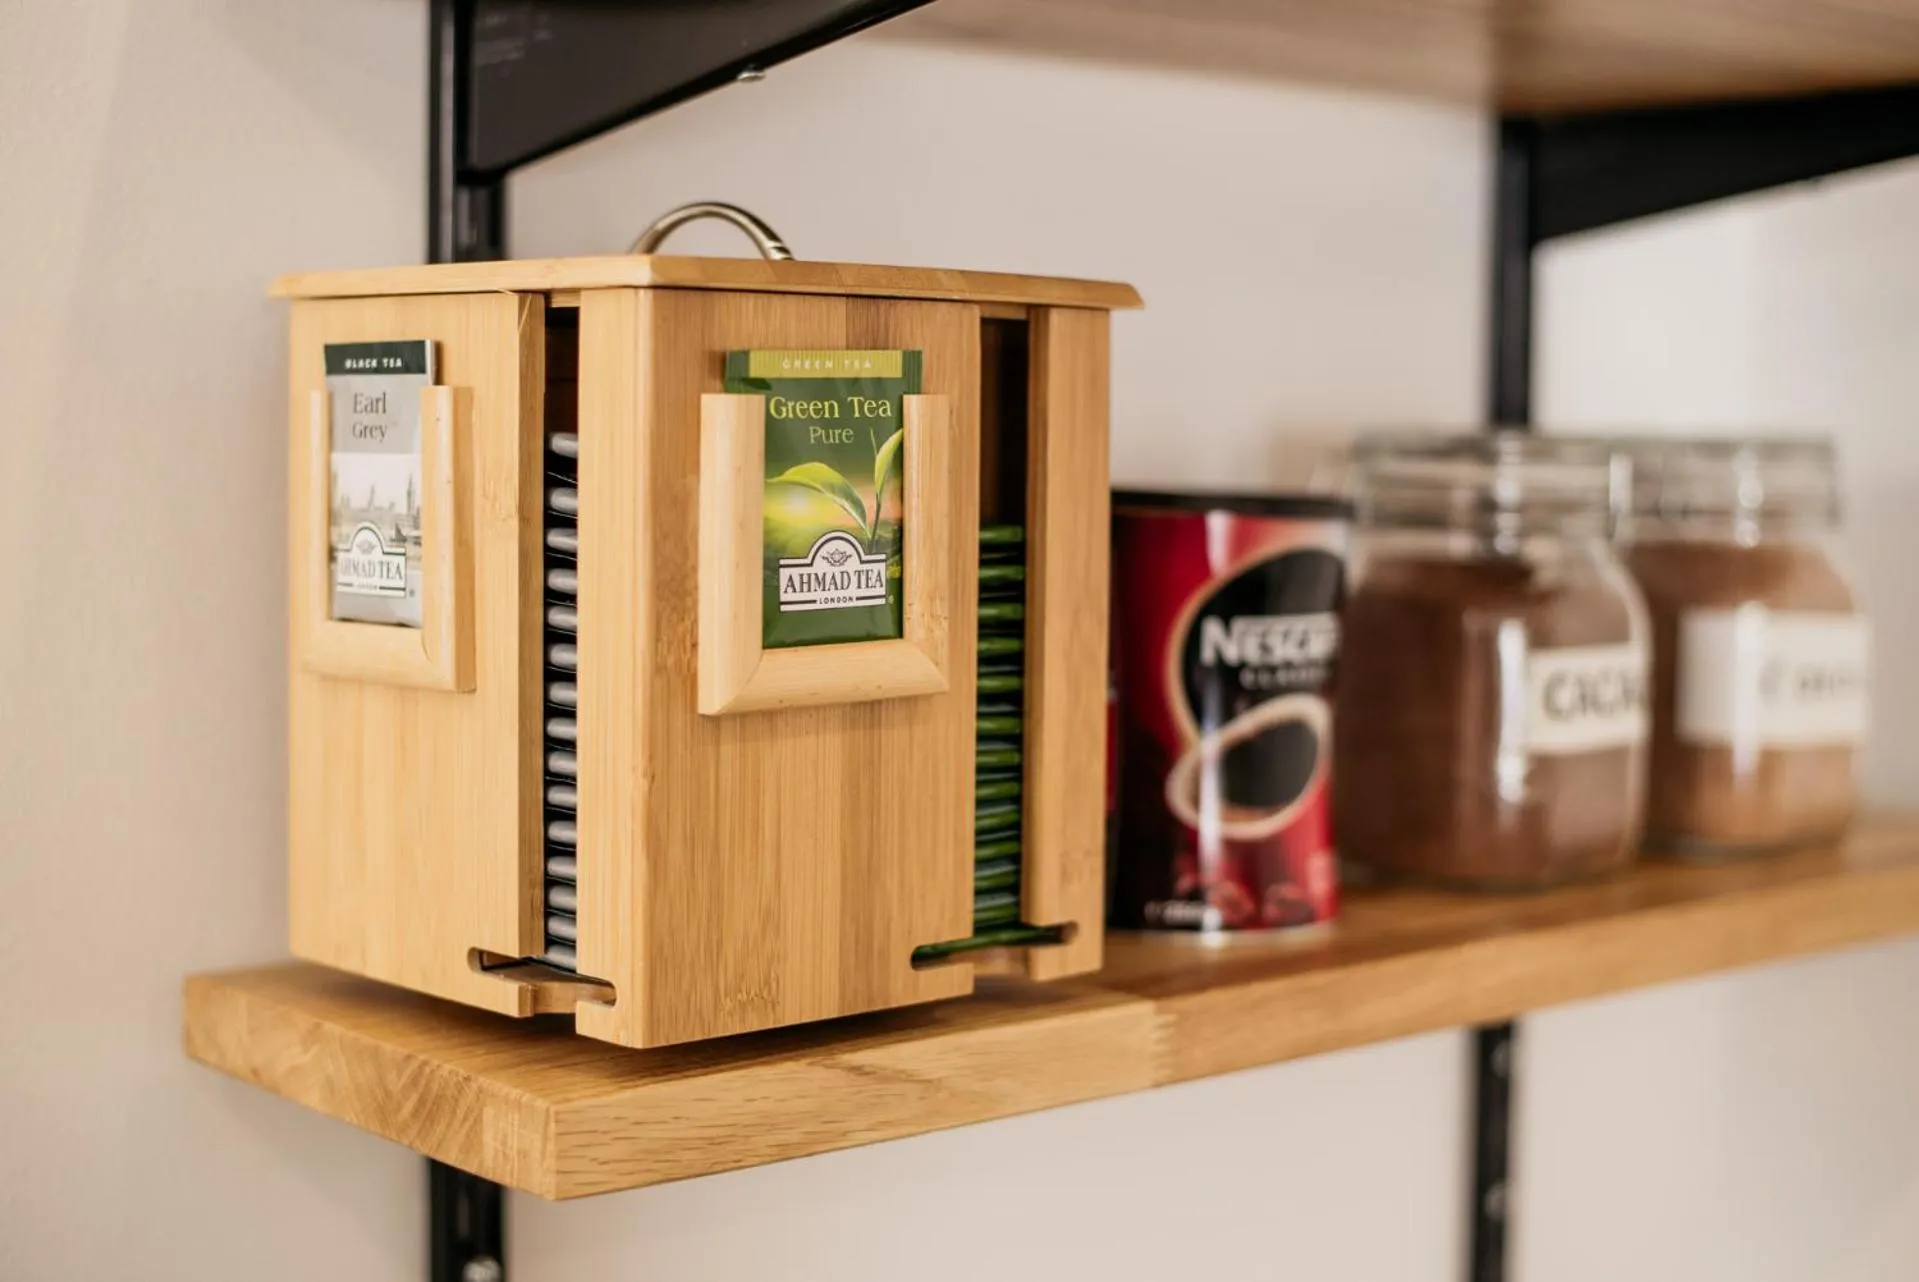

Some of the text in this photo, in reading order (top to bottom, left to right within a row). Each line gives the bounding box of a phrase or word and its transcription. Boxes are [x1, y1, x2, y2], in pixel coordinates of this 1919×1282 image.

[344, 357, 402, 369] BLACK TEA
[782, 358, 872, 370] GREEN TEA
[353, 391, 387, 415] Earl
[769, 395, 892, 420] Green Tea
[351, 420, 388, 444] Grey
[808, 426, 854, 445] Pure
[377, 560, 403, 581] TEA
[783, 568, 884, 594] AHMAD TEA
[818, 596, 854, 605] LONDON
[1201, 612, 1340, 667] NESCAF
